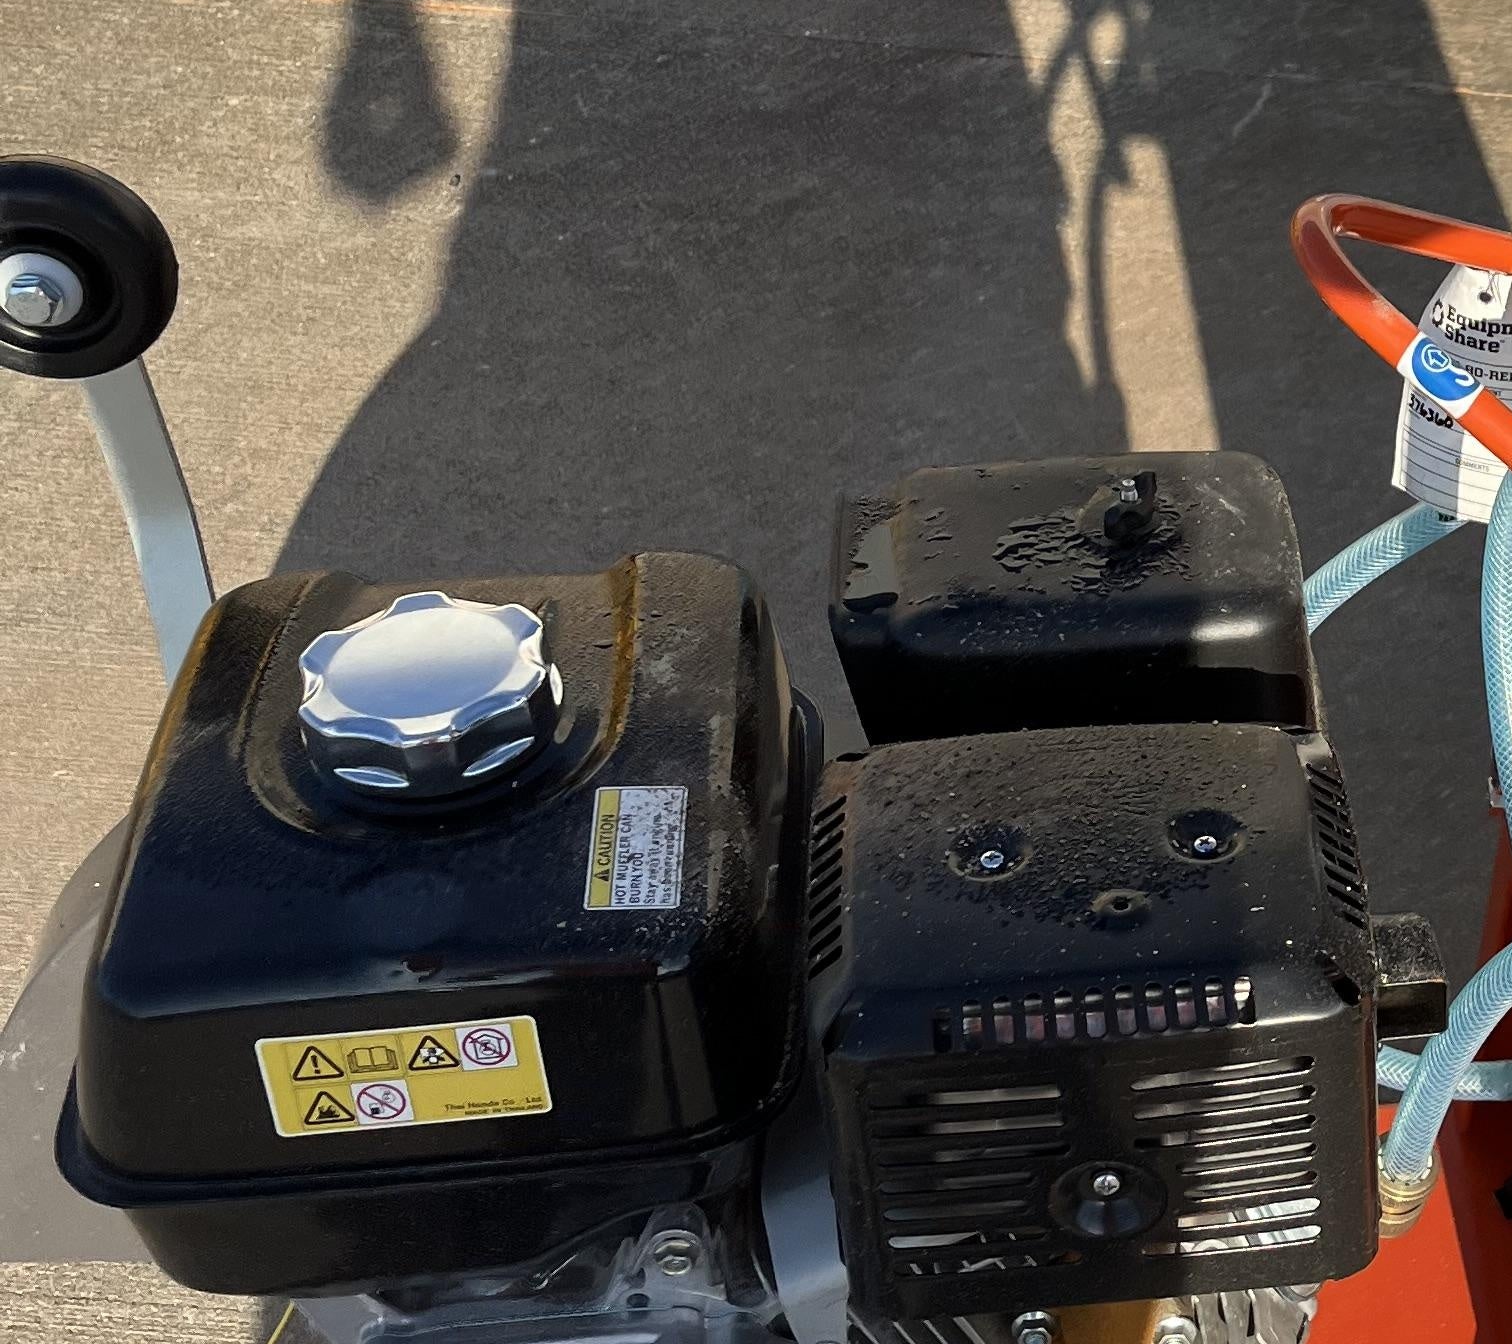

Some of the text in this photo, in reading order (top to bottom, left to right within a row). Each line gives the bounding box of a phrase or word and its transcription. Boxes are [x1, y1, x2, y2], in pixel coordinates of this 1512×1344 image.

[1408, 393, 1454, 430] 376360
[597, 813, 616, 867] CAUTION
[614, 883, 626, 905] HOT
[620, 813, 633, 834] CAN
[628, 874, 642, 904] BURN
